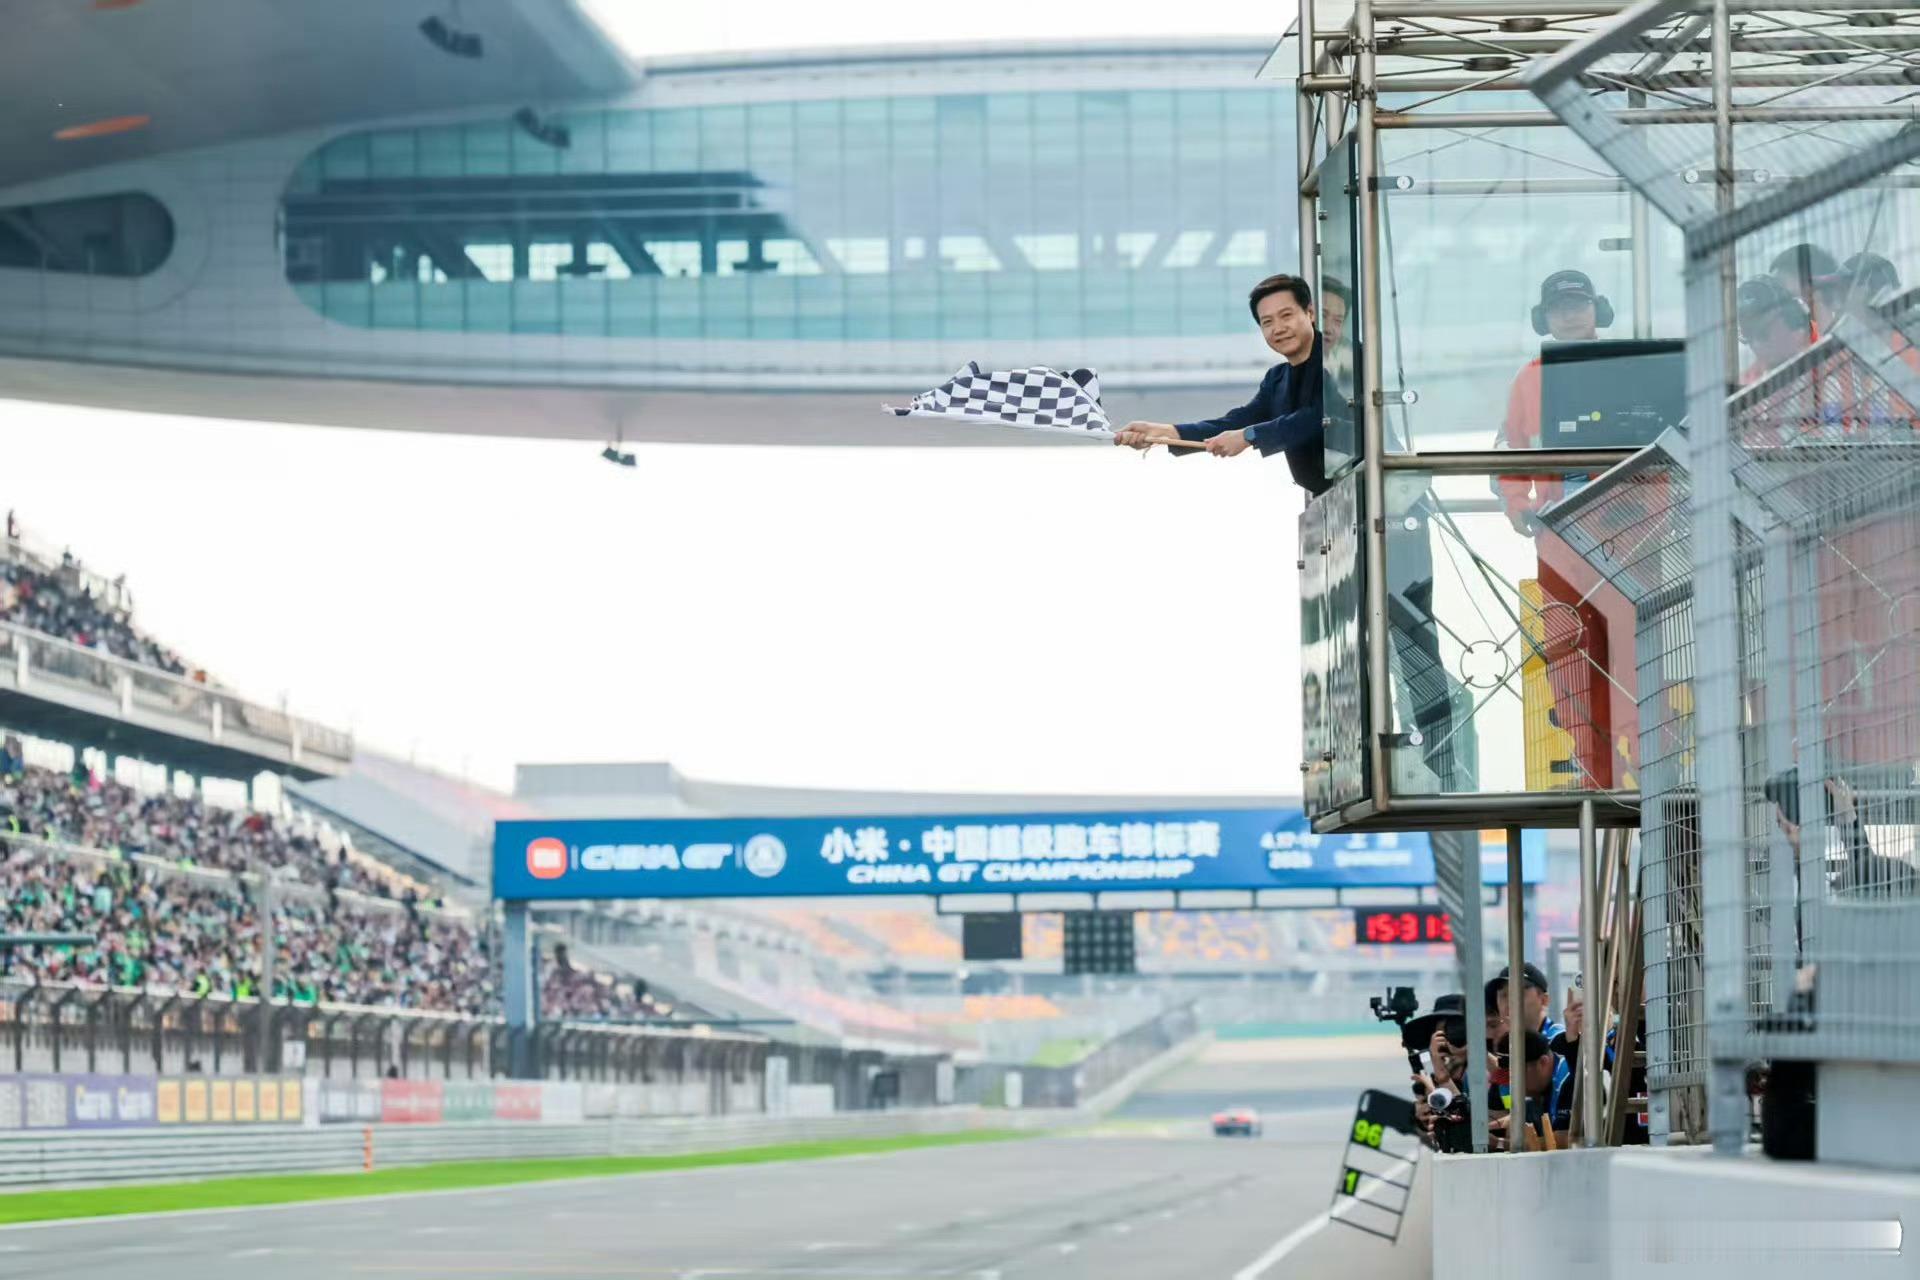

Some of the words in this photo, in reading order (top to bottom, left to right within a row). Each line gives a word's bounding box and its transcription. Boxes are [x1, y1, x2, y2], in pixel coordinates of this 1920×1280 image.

[847, 864, 931, 883] CHINA
[937, 862, 979, 882] GT
[982, 858, 1195, 881] CHAMPIONSHIP
[1354, 1119, 1383, 1147] 96
[1346, 1171, 1357, 1193] 1
